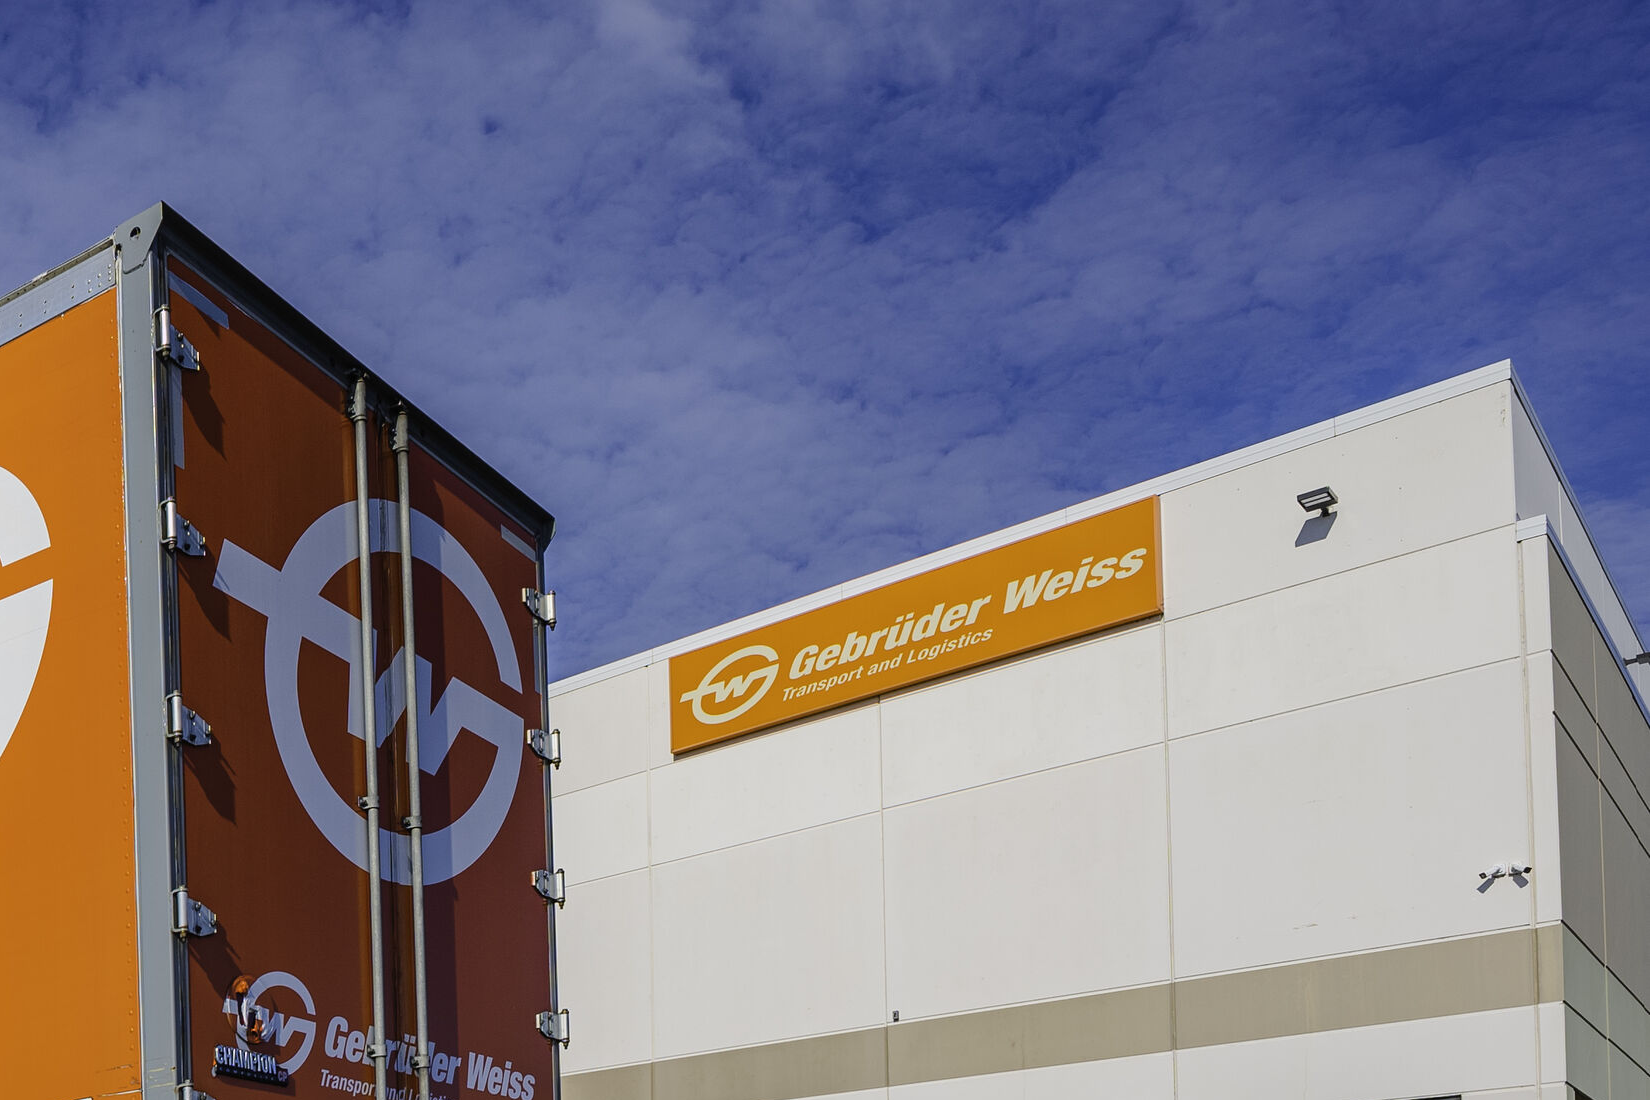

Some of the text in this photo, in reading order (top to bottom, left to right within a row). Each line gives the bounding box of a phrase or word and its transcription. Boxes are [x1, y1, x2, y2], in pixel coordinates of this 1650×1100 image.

[789, 595, 991, 680] Gebrüder
[1003, 548, 1147, 615] Weiss
[782, 629, 993, 701] Transport and Logistics
[215, 1044, 277, 1075] CHAMPION
[320, 1069, 377, 1097] Transpor
